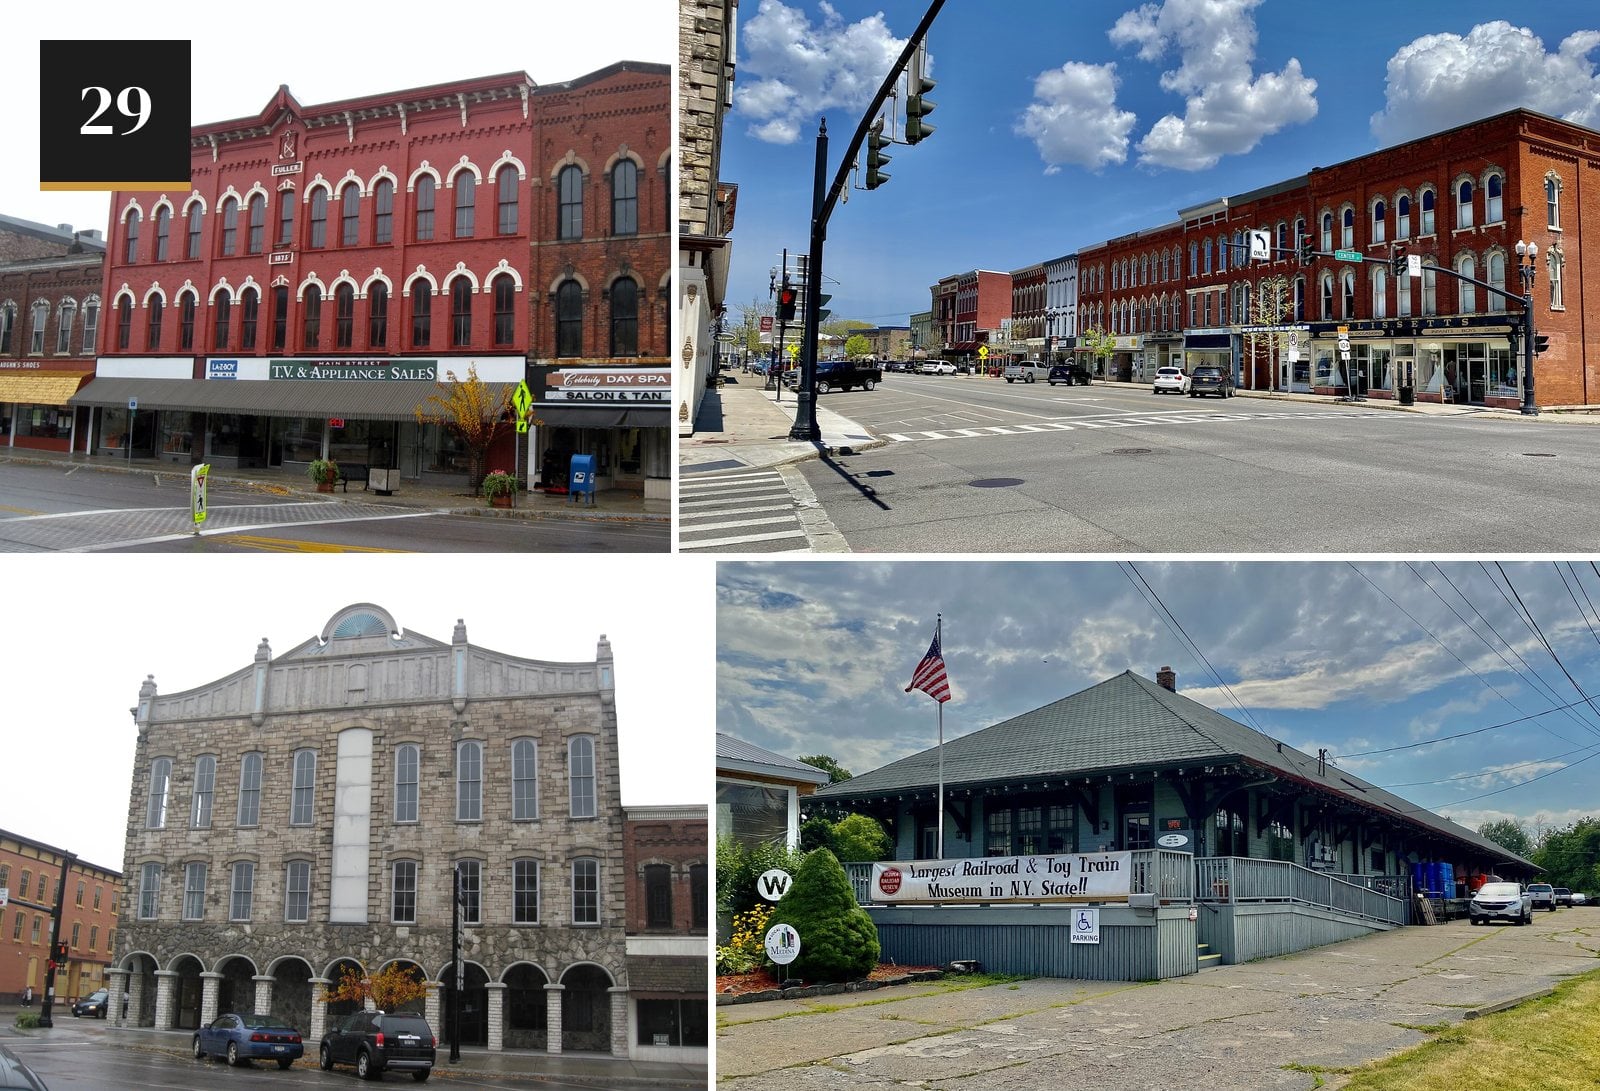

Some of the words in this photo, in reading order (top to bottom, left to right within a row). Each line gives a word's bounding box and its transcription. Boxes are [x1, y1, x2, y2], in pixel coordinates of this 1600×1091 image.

[272, 365, 294, 379] T.V.
[296, 367, 308, 378] &
[309, 366, 386, 380] APPLIANCE
[391, 366, 435, 380] SALES
[563, 372, 601, 386] Celebrity
[606, 375, 634, 383] DAY
[638, 375, 667, 383] SPA
[566, 392, 614, 400] SALON
[618, 392, 628, 400] &
[632, 392, 662, 400] TAN
[909, 863, 957, 880] Largest
[962, 860, 1019, 877] Railroad
[1026, 858, 1038, 874] &
[1046, 857, 1071, 878] Toy
[1078, 856, 1120, 873] Train
[762, 875, 788, 895] W
[927, 882, 982, 898] Museum
[990, 881, 1003, 896] in
[1010, 880, 1035, 896] N.Y.
[1041, 876, 1088, 896] State!!
[1072, 934, 1099, 942] PARKING
